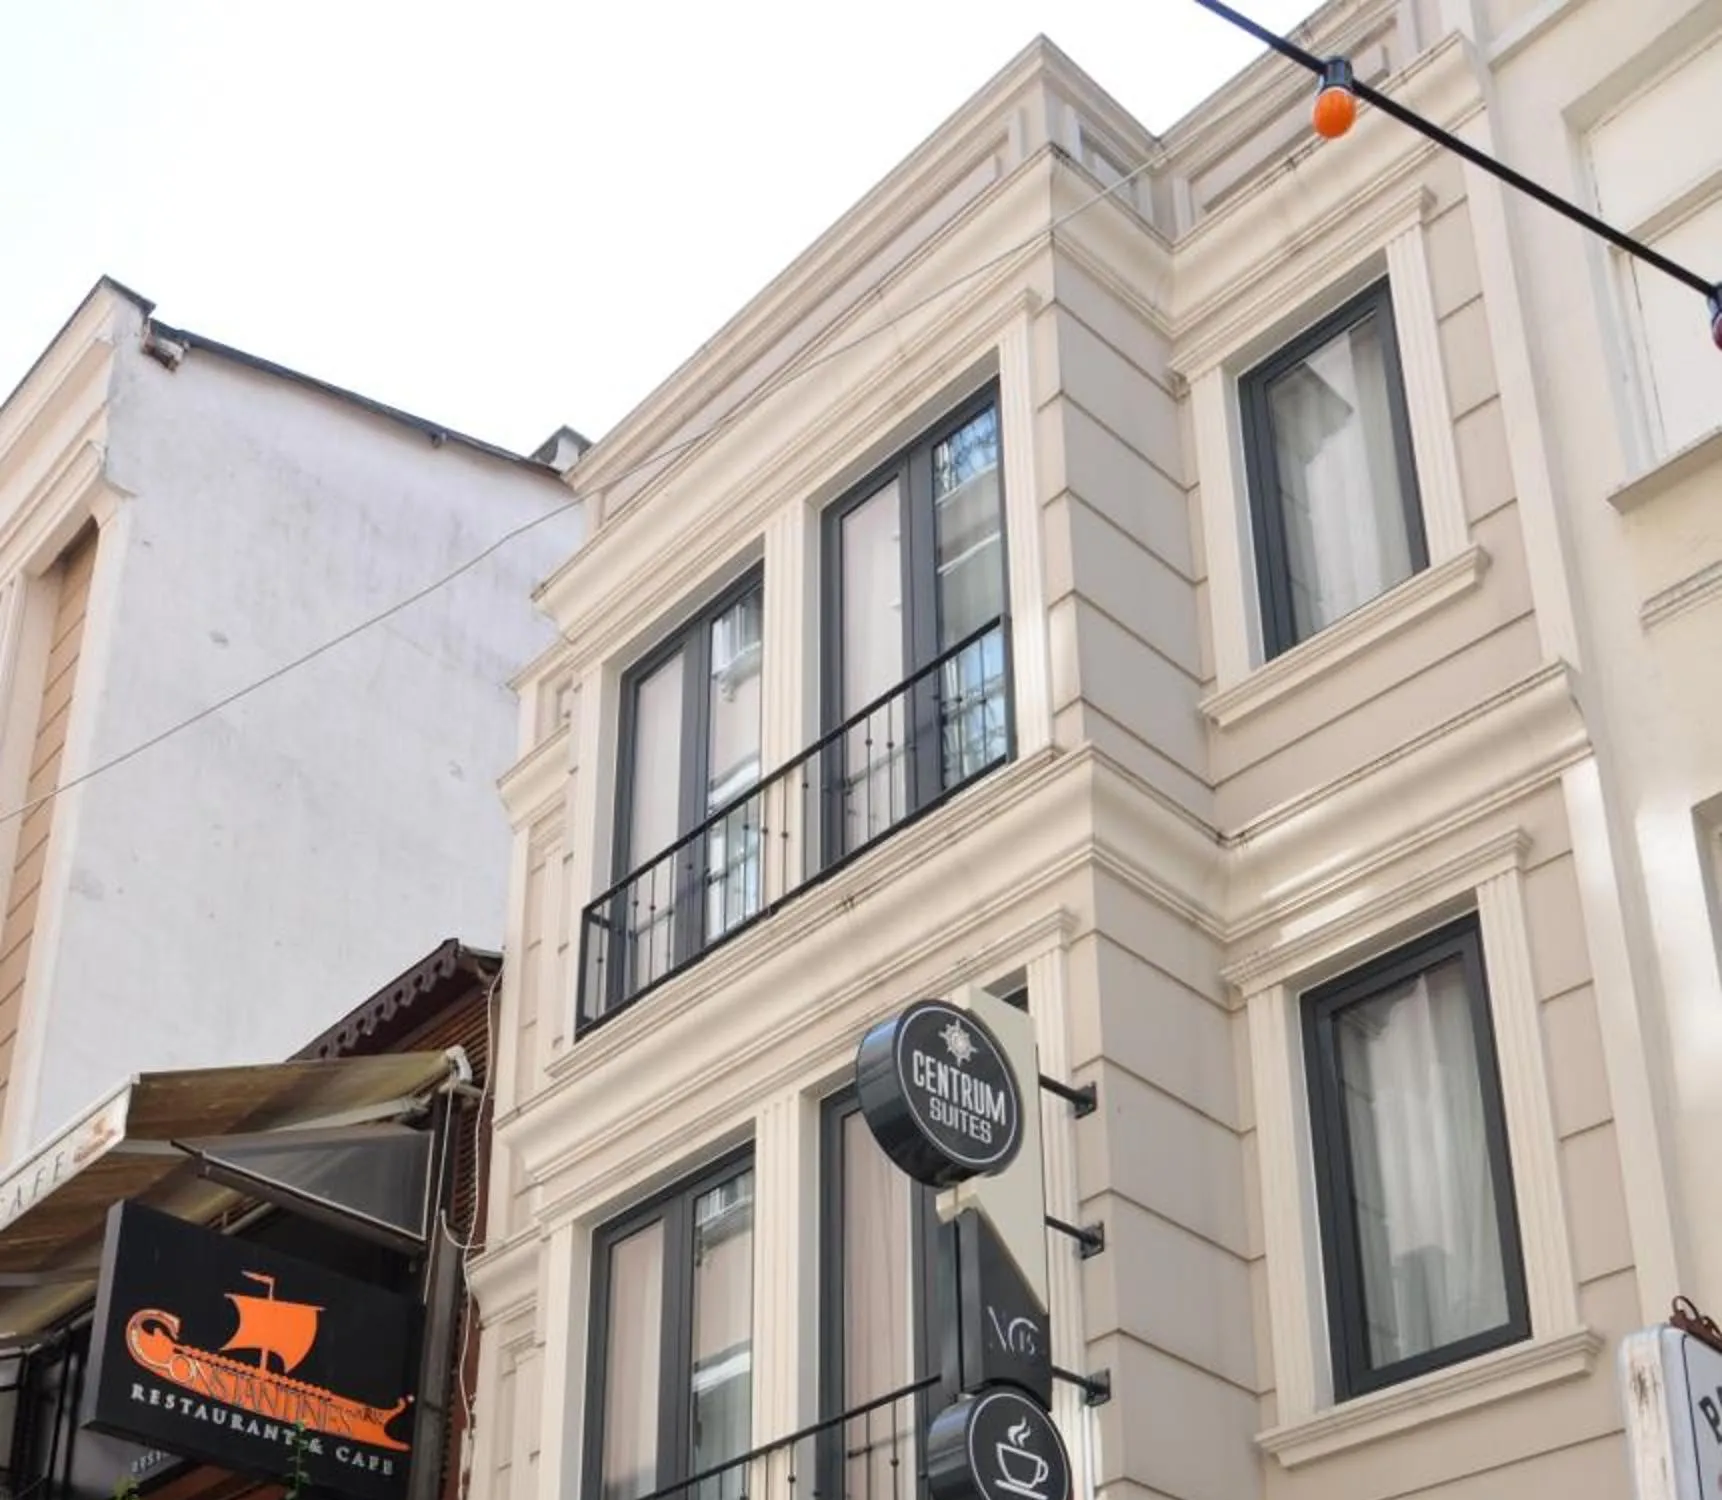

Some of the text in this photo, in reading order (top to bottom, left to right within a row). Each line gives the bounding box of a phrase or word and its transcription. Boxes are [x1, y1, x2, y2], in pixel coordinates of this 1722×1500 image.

[913, 1050, 1006, 1126] CENTRUM
[929, 1096, 992, 1144] SUITES
[130, 1383, 394, 1476] RESTAURANT & CAFE
